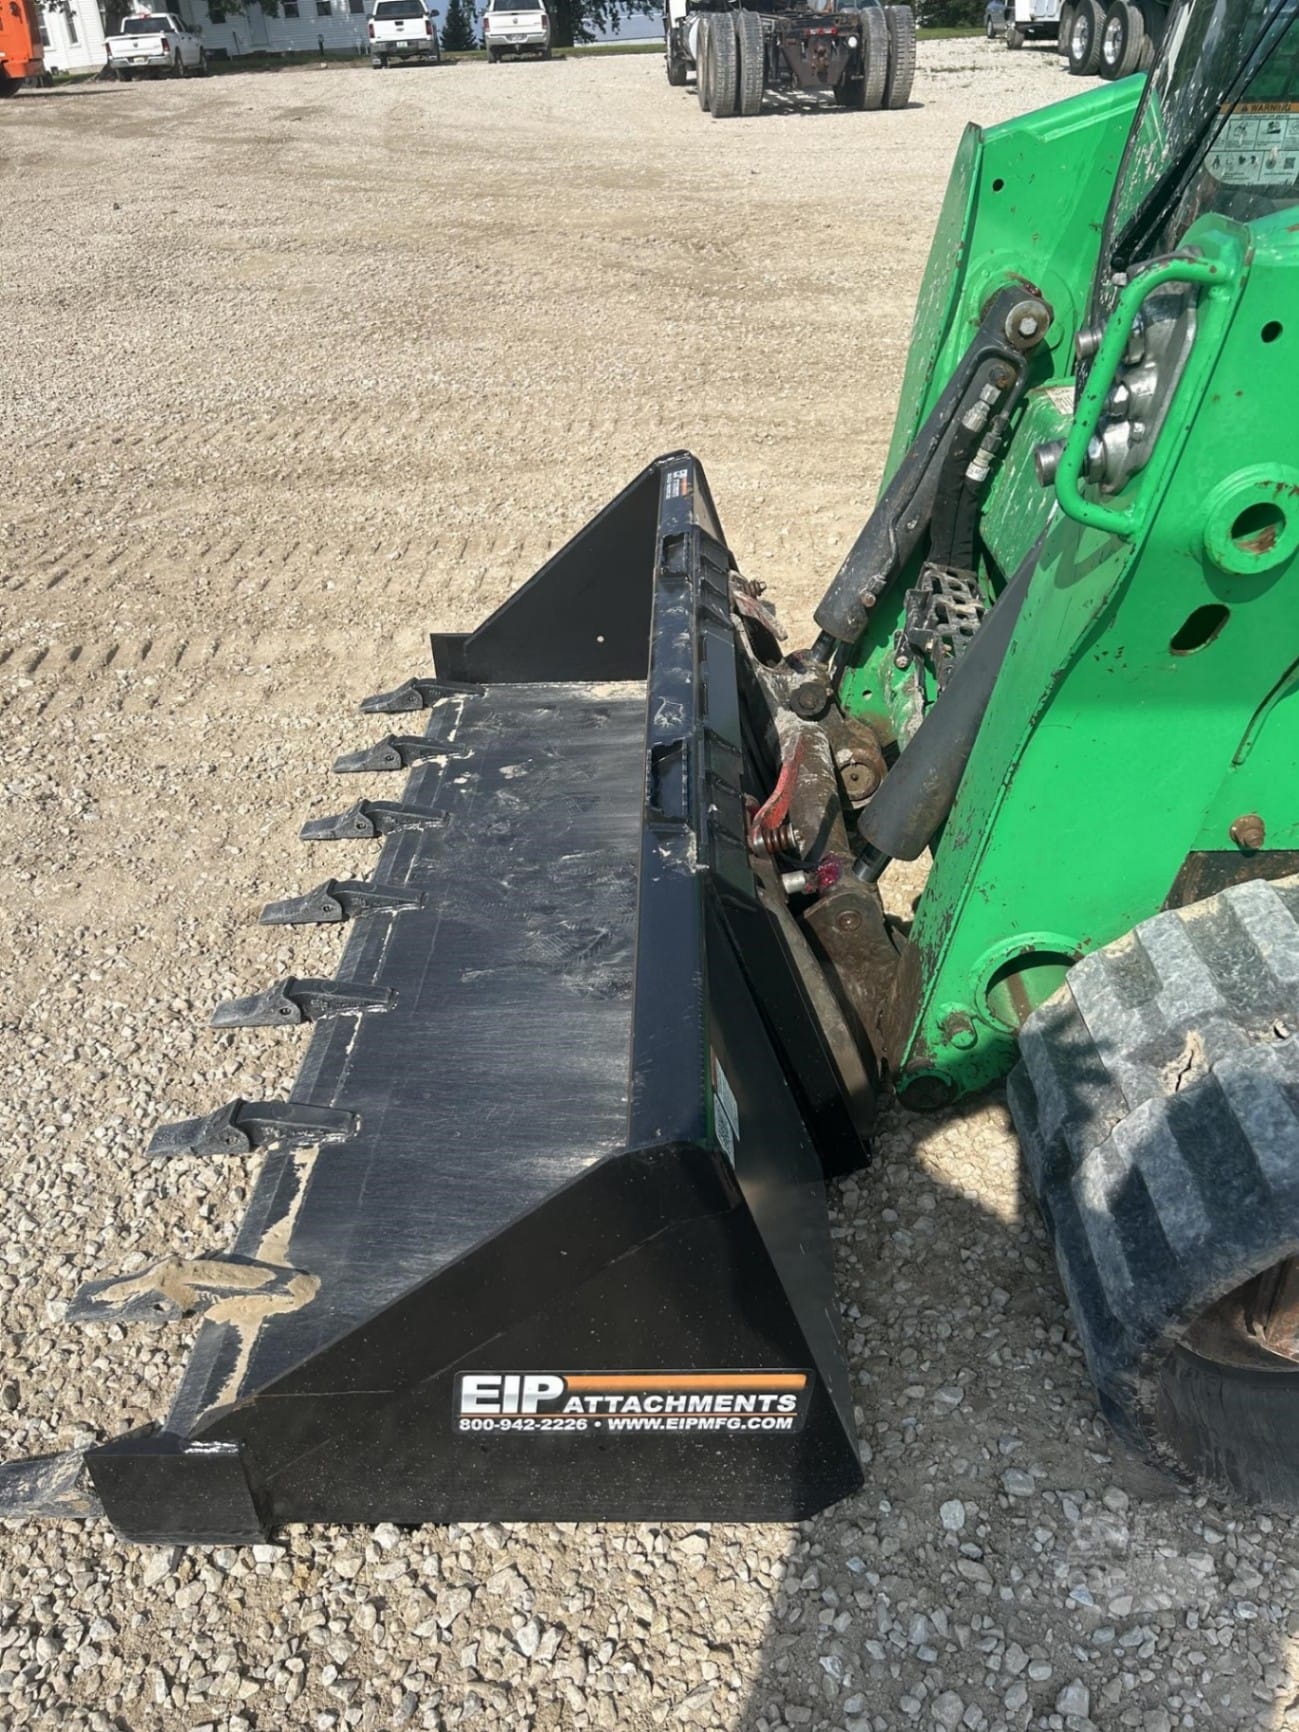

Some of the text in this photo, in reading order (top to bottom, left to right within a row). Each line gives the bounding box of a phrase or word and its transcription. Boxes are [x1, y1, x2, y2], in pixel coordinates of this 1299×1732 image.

[461, 1375, 797, 1414] EIP ATTACHMENTS
[459, 1417, 794, 1431] 800-942-2226 WWW.EIPMFG.COM
